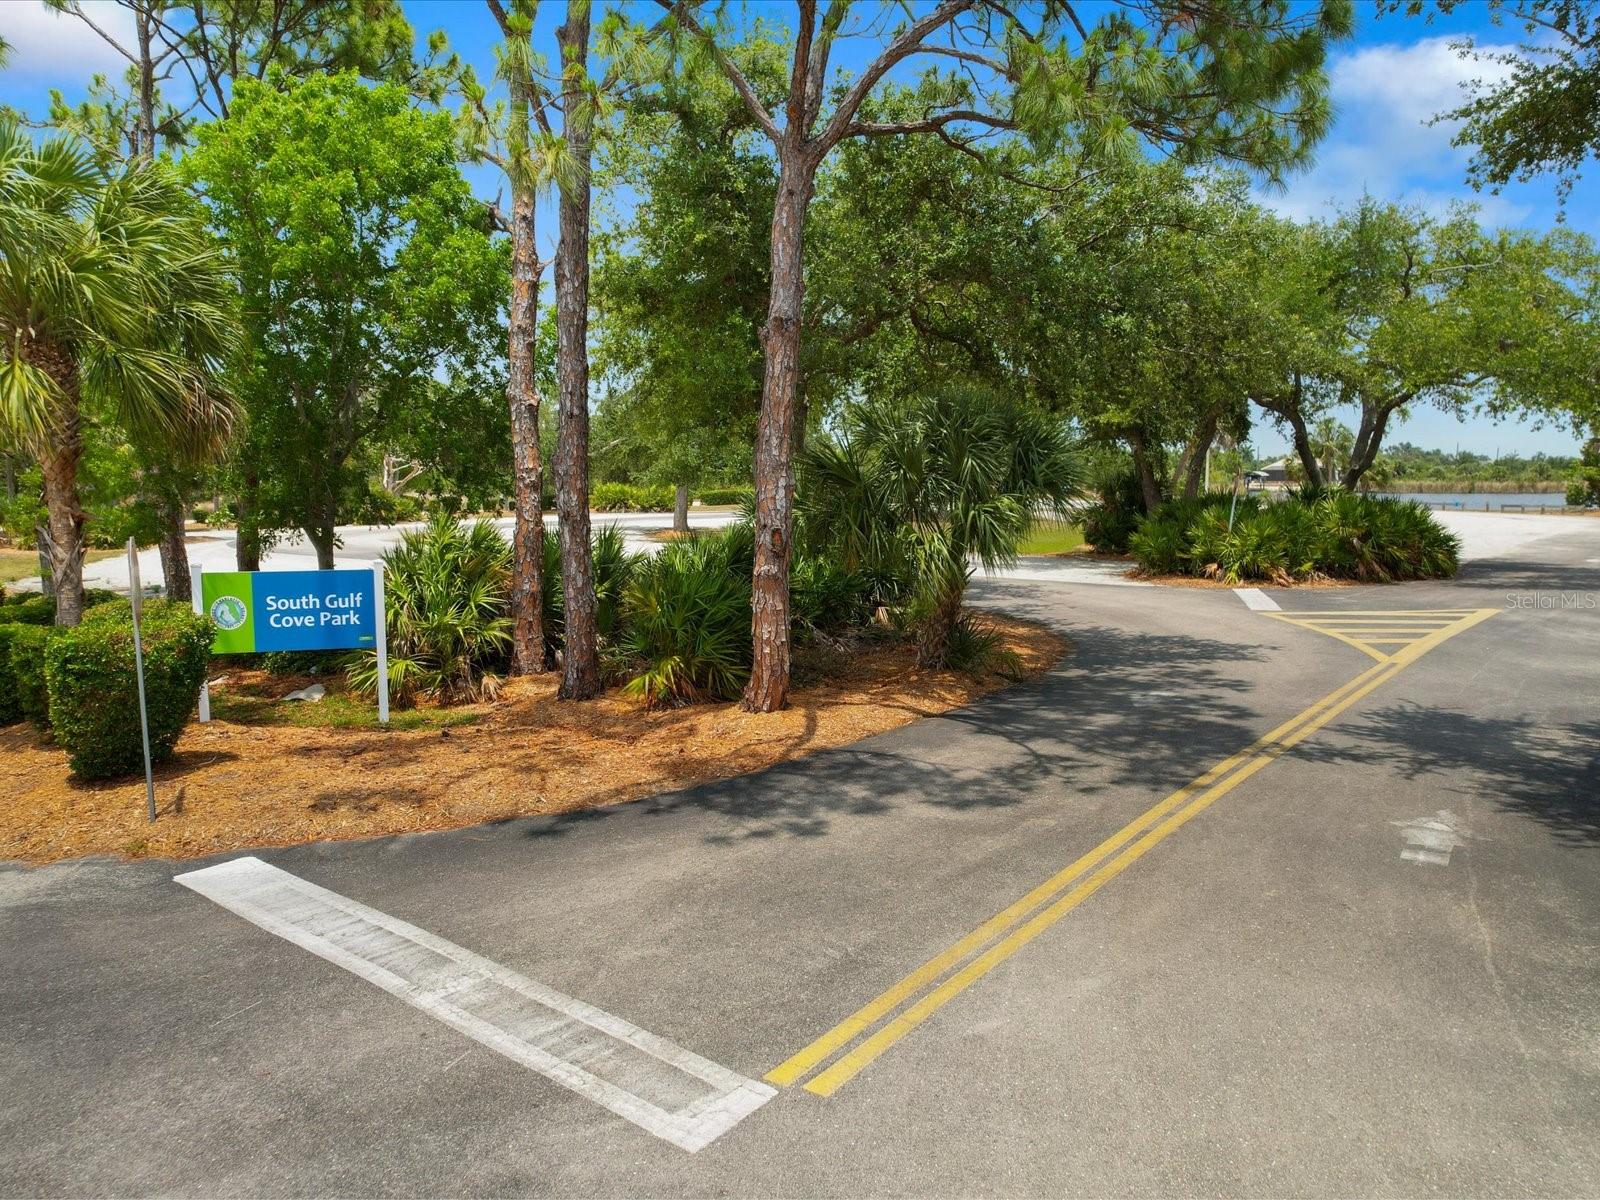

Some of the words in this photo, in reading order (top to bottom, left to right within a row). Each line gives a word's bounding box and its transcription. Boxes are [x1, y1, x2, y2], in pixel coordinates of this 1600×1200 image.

[266, 594, 320, 611] South
[325, 592, 362, 609] Gulf
[269, 613, 315, 628] Cove
[320, 610, 360, 626] Park
